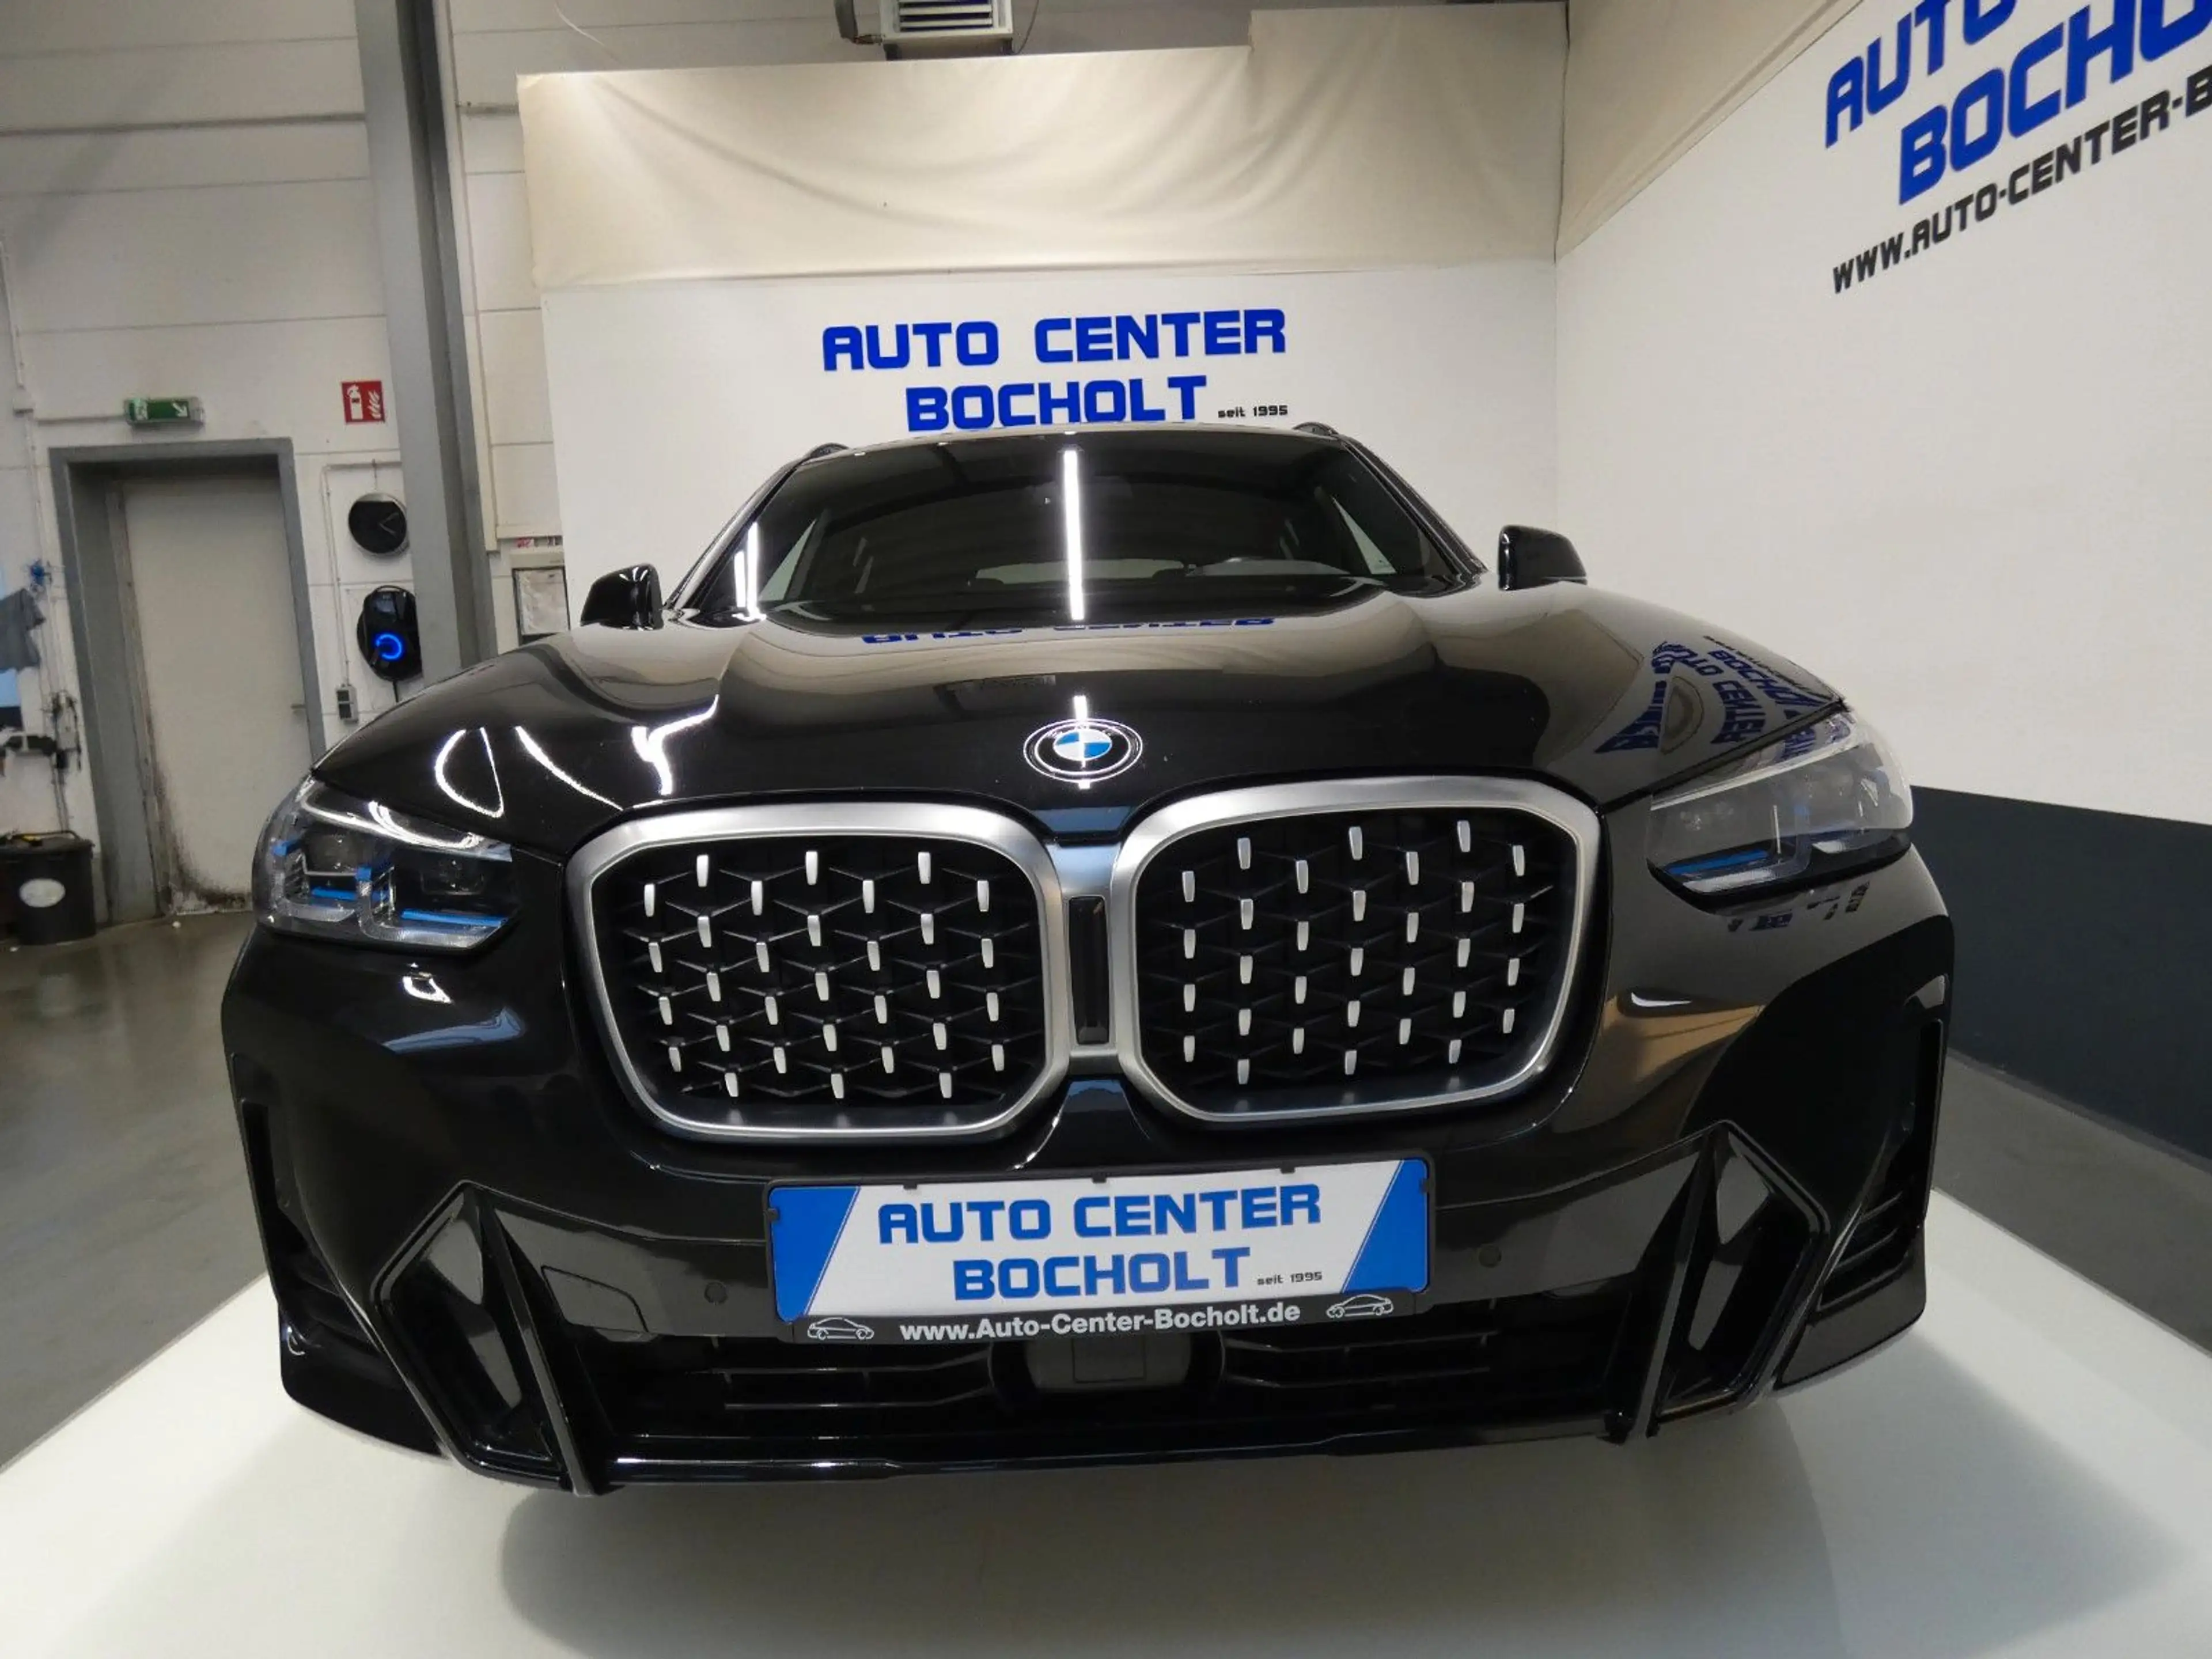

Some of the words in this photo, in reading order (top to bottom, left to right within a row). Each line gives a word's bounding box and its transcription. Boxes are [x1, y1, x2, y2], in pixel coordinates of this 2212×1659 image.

[822, 320, 1000, 372] AUTO
[1034, 308, 1286, 364] CENTER
[905, 374, 1207, 433] BOCHOLT
[1218, 406, 1246, 418] seit
[1253, 405, 1288, 416] 1995
[878, 1198, 1053, 1245] AUTO
[1073, 1183, 1321, 1238] CENTER
[953, 1247, 1250, 1302] BOCHOLT
[1257, 1274, 1283, 1285] seit
[1290, 1271, 1323, 1283] 1995
[899, 1302, 1301, 1341] www.Auto-Center-Bocholt.de
